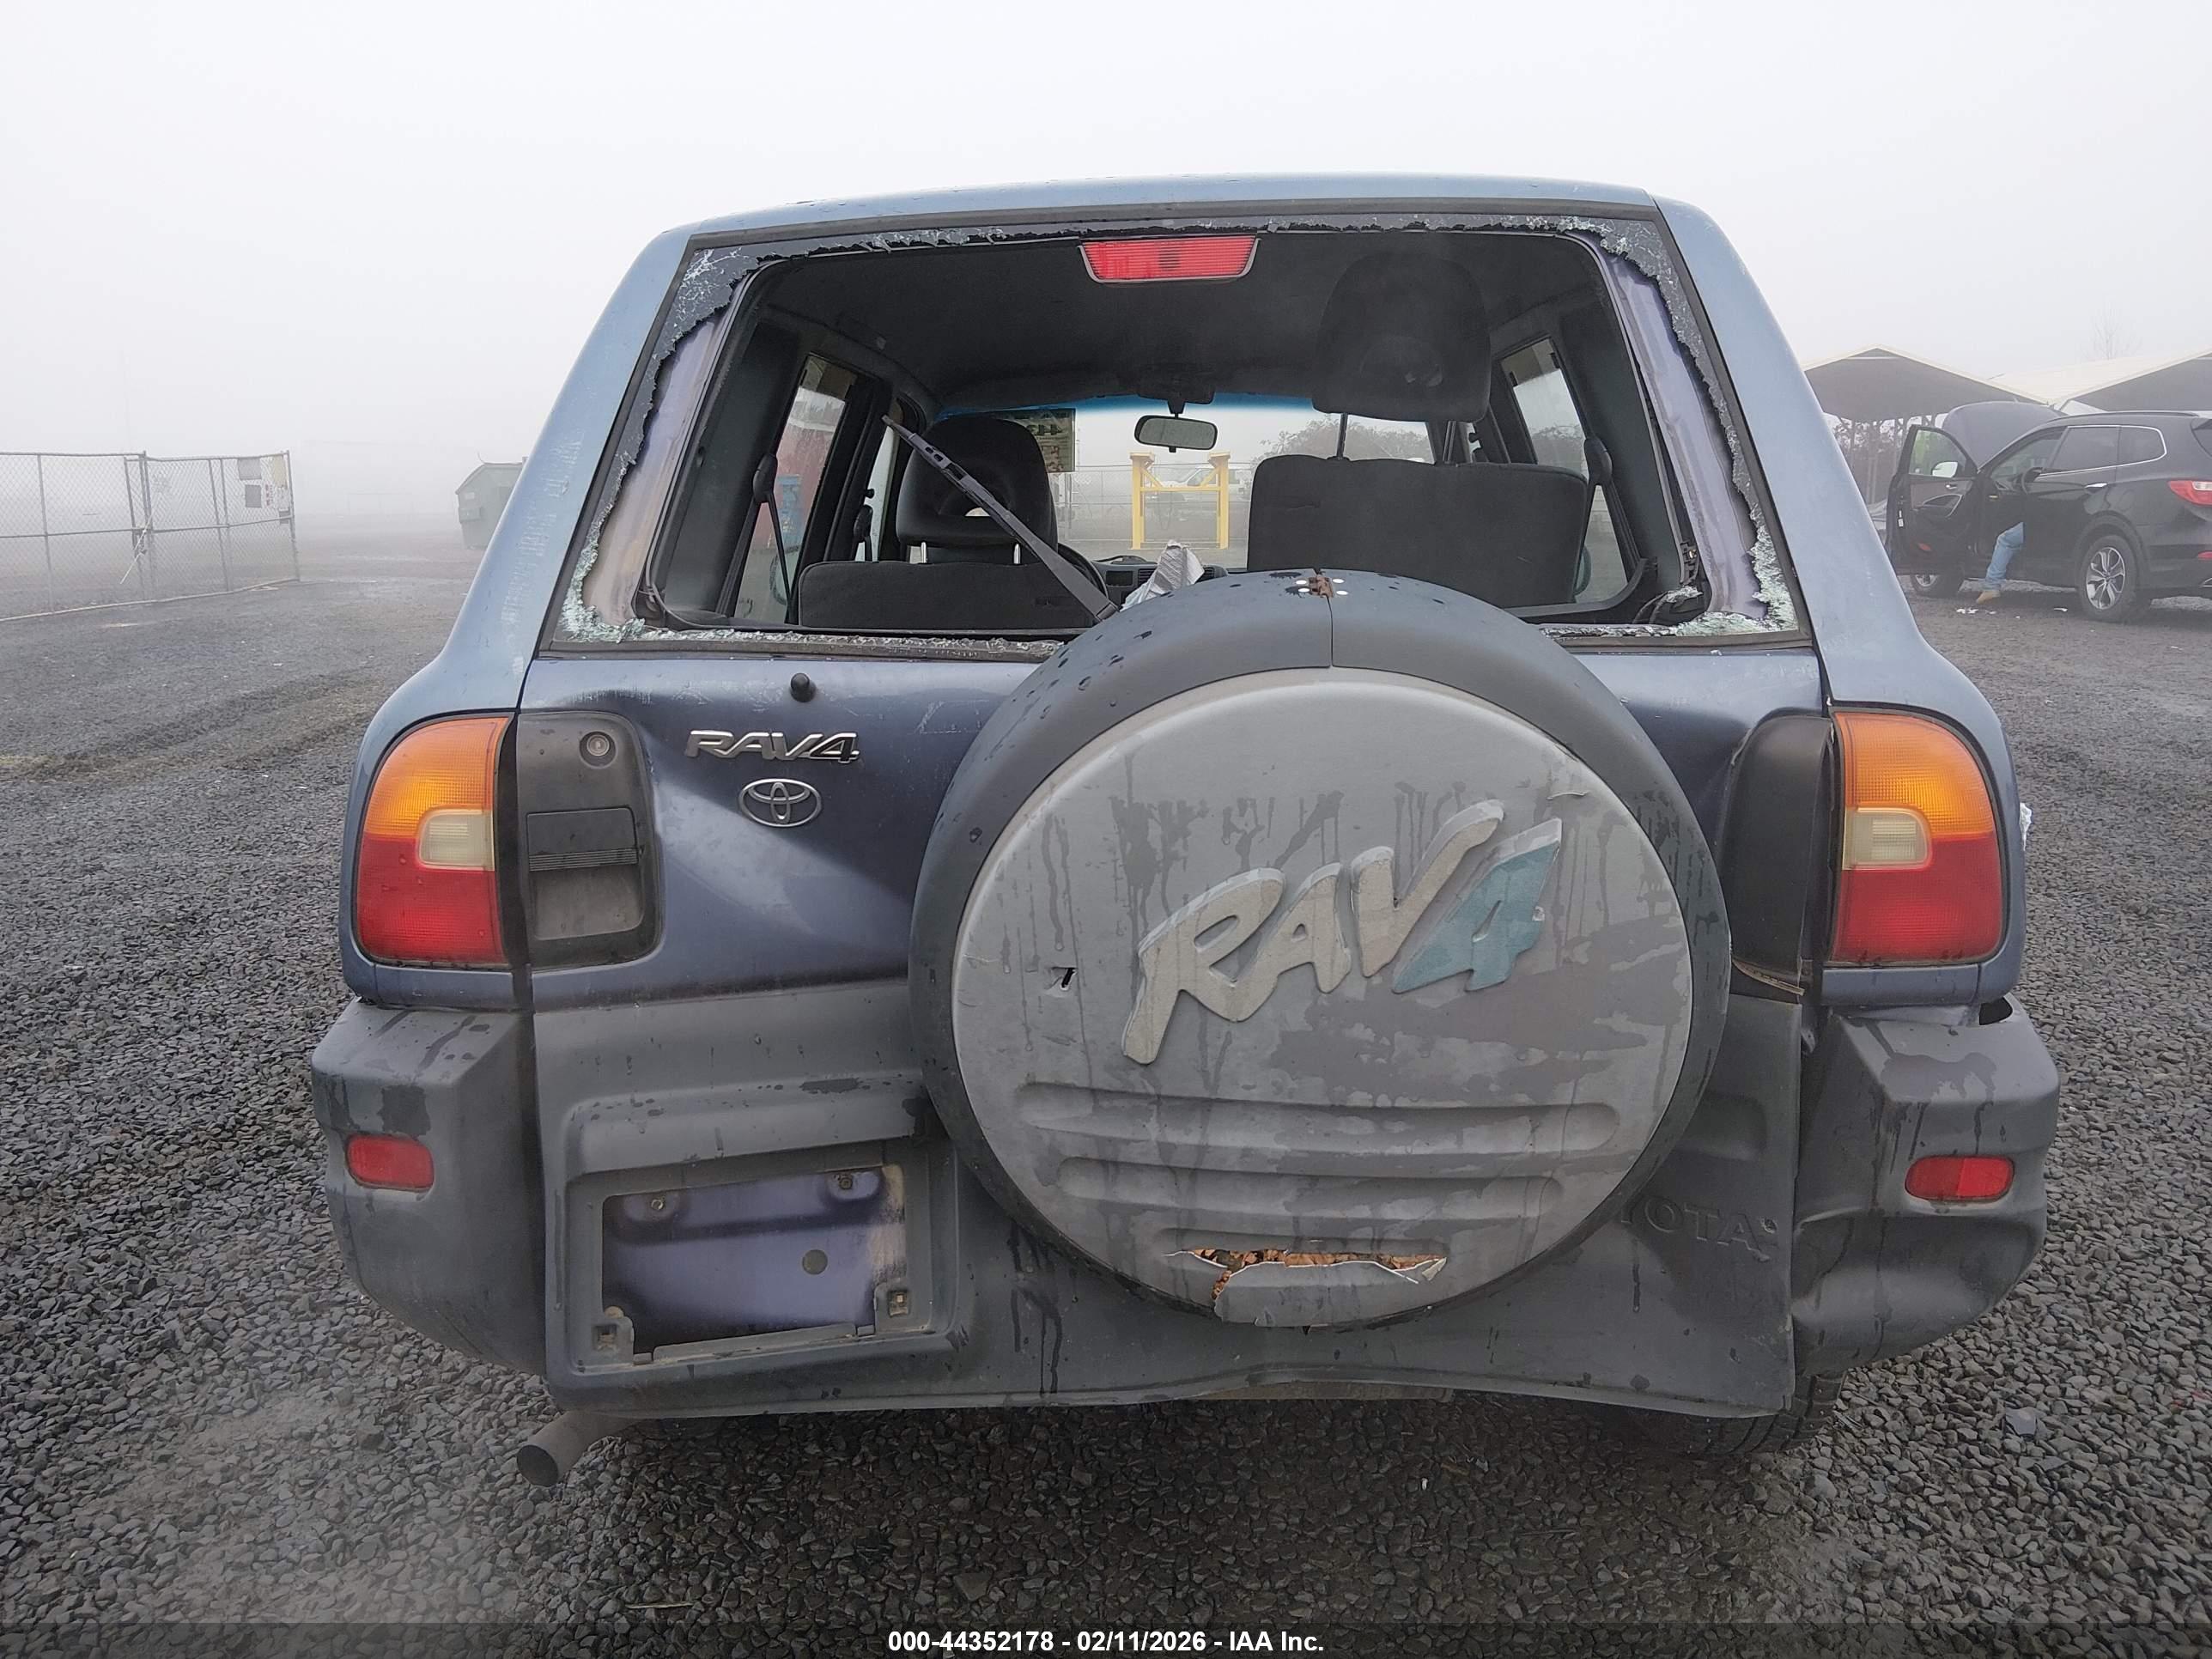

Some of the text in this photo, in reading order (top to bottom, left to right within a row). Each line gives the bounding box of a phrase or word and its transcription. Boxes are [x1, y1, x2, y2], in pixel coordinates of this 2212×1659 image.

[684, 730, 860, 764] RAV4
[1122, 799, 1562, 1066] RAV4
[1621, 1194, 1771, 1262] OTA
